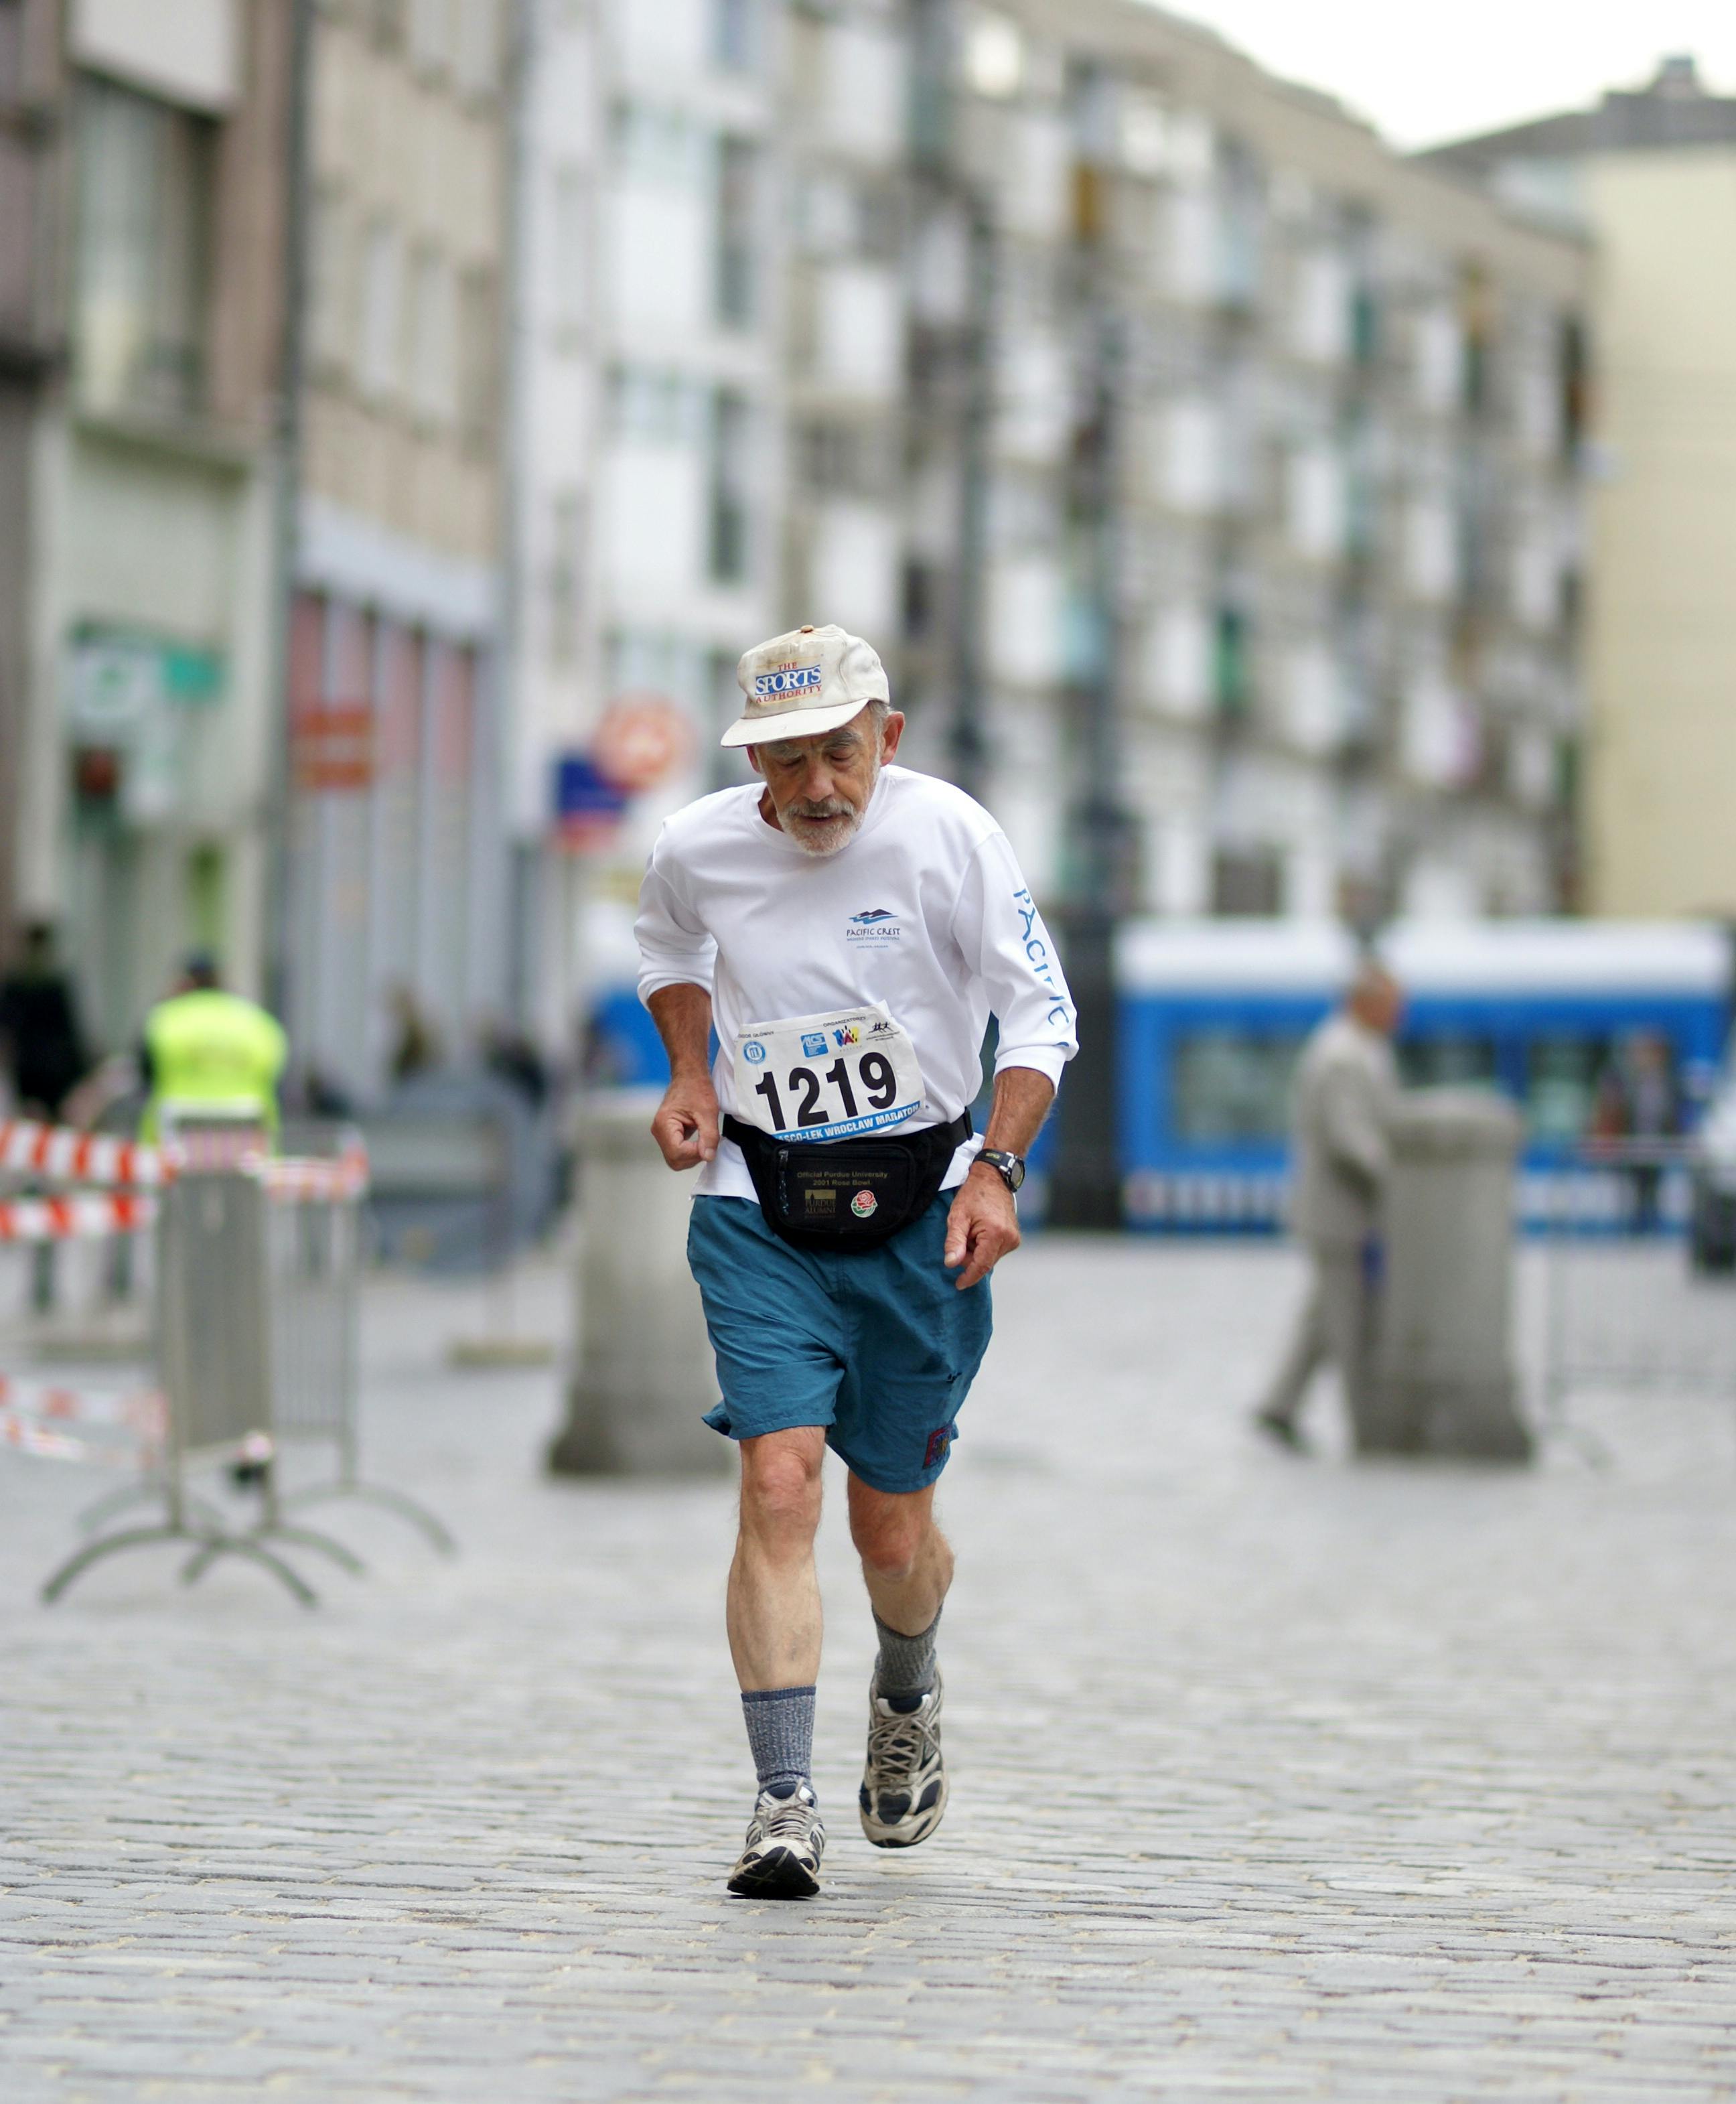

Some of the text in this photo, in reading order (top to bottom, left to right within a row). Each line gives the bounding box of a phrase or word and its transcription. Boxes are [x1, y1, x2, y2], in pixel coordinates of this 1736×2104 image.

[778, 662, 798, 671] THE
[756, 667, 820, 695] SPORTS
[756, 685, 822, 703] AUTHORITY
[847, 928, 875, 936] PACIFIC
[755, 1052, 897, 1131] 1219
[824, 1117, 874, 1137] WROCŁAW
[875, 1105, 920, 1125] MARATON
[852, 1171, 889, 1179] University
